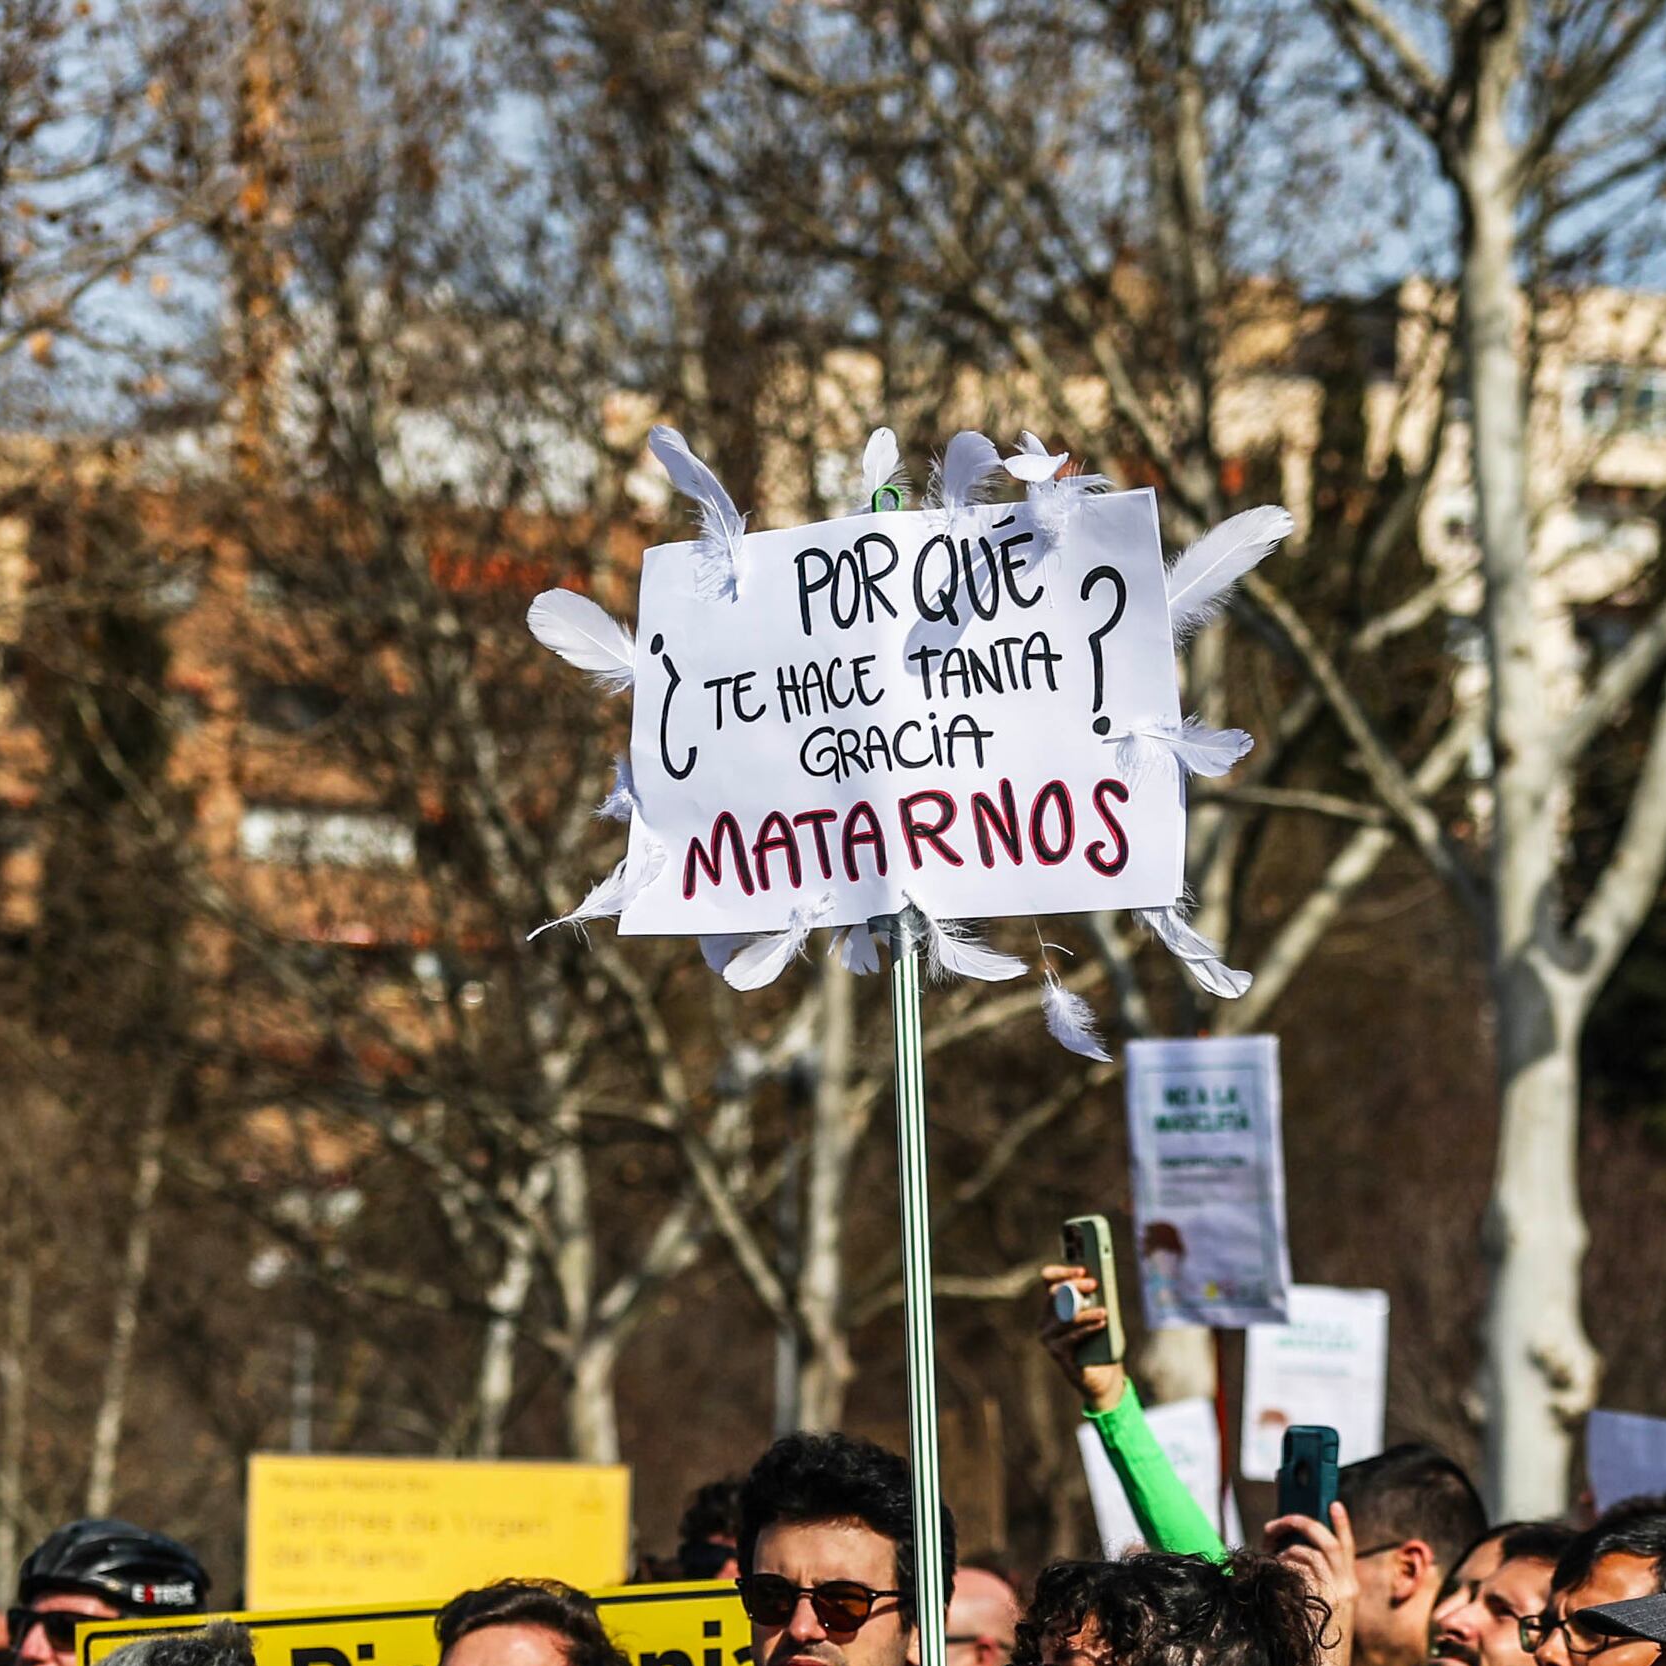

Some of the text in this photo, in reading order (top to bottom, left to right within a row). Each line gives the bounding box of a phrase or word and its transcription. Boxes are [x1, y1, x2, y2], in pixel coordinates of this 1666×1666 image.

[794, 515, 1044, 636] POR QUÉ
[703, 670, 767, 731] TE
[776, 654, 886, 724] HACE
[908, 631, 1063, 699] TANTA
[681, 776, 1131, 901] MATARNOS
